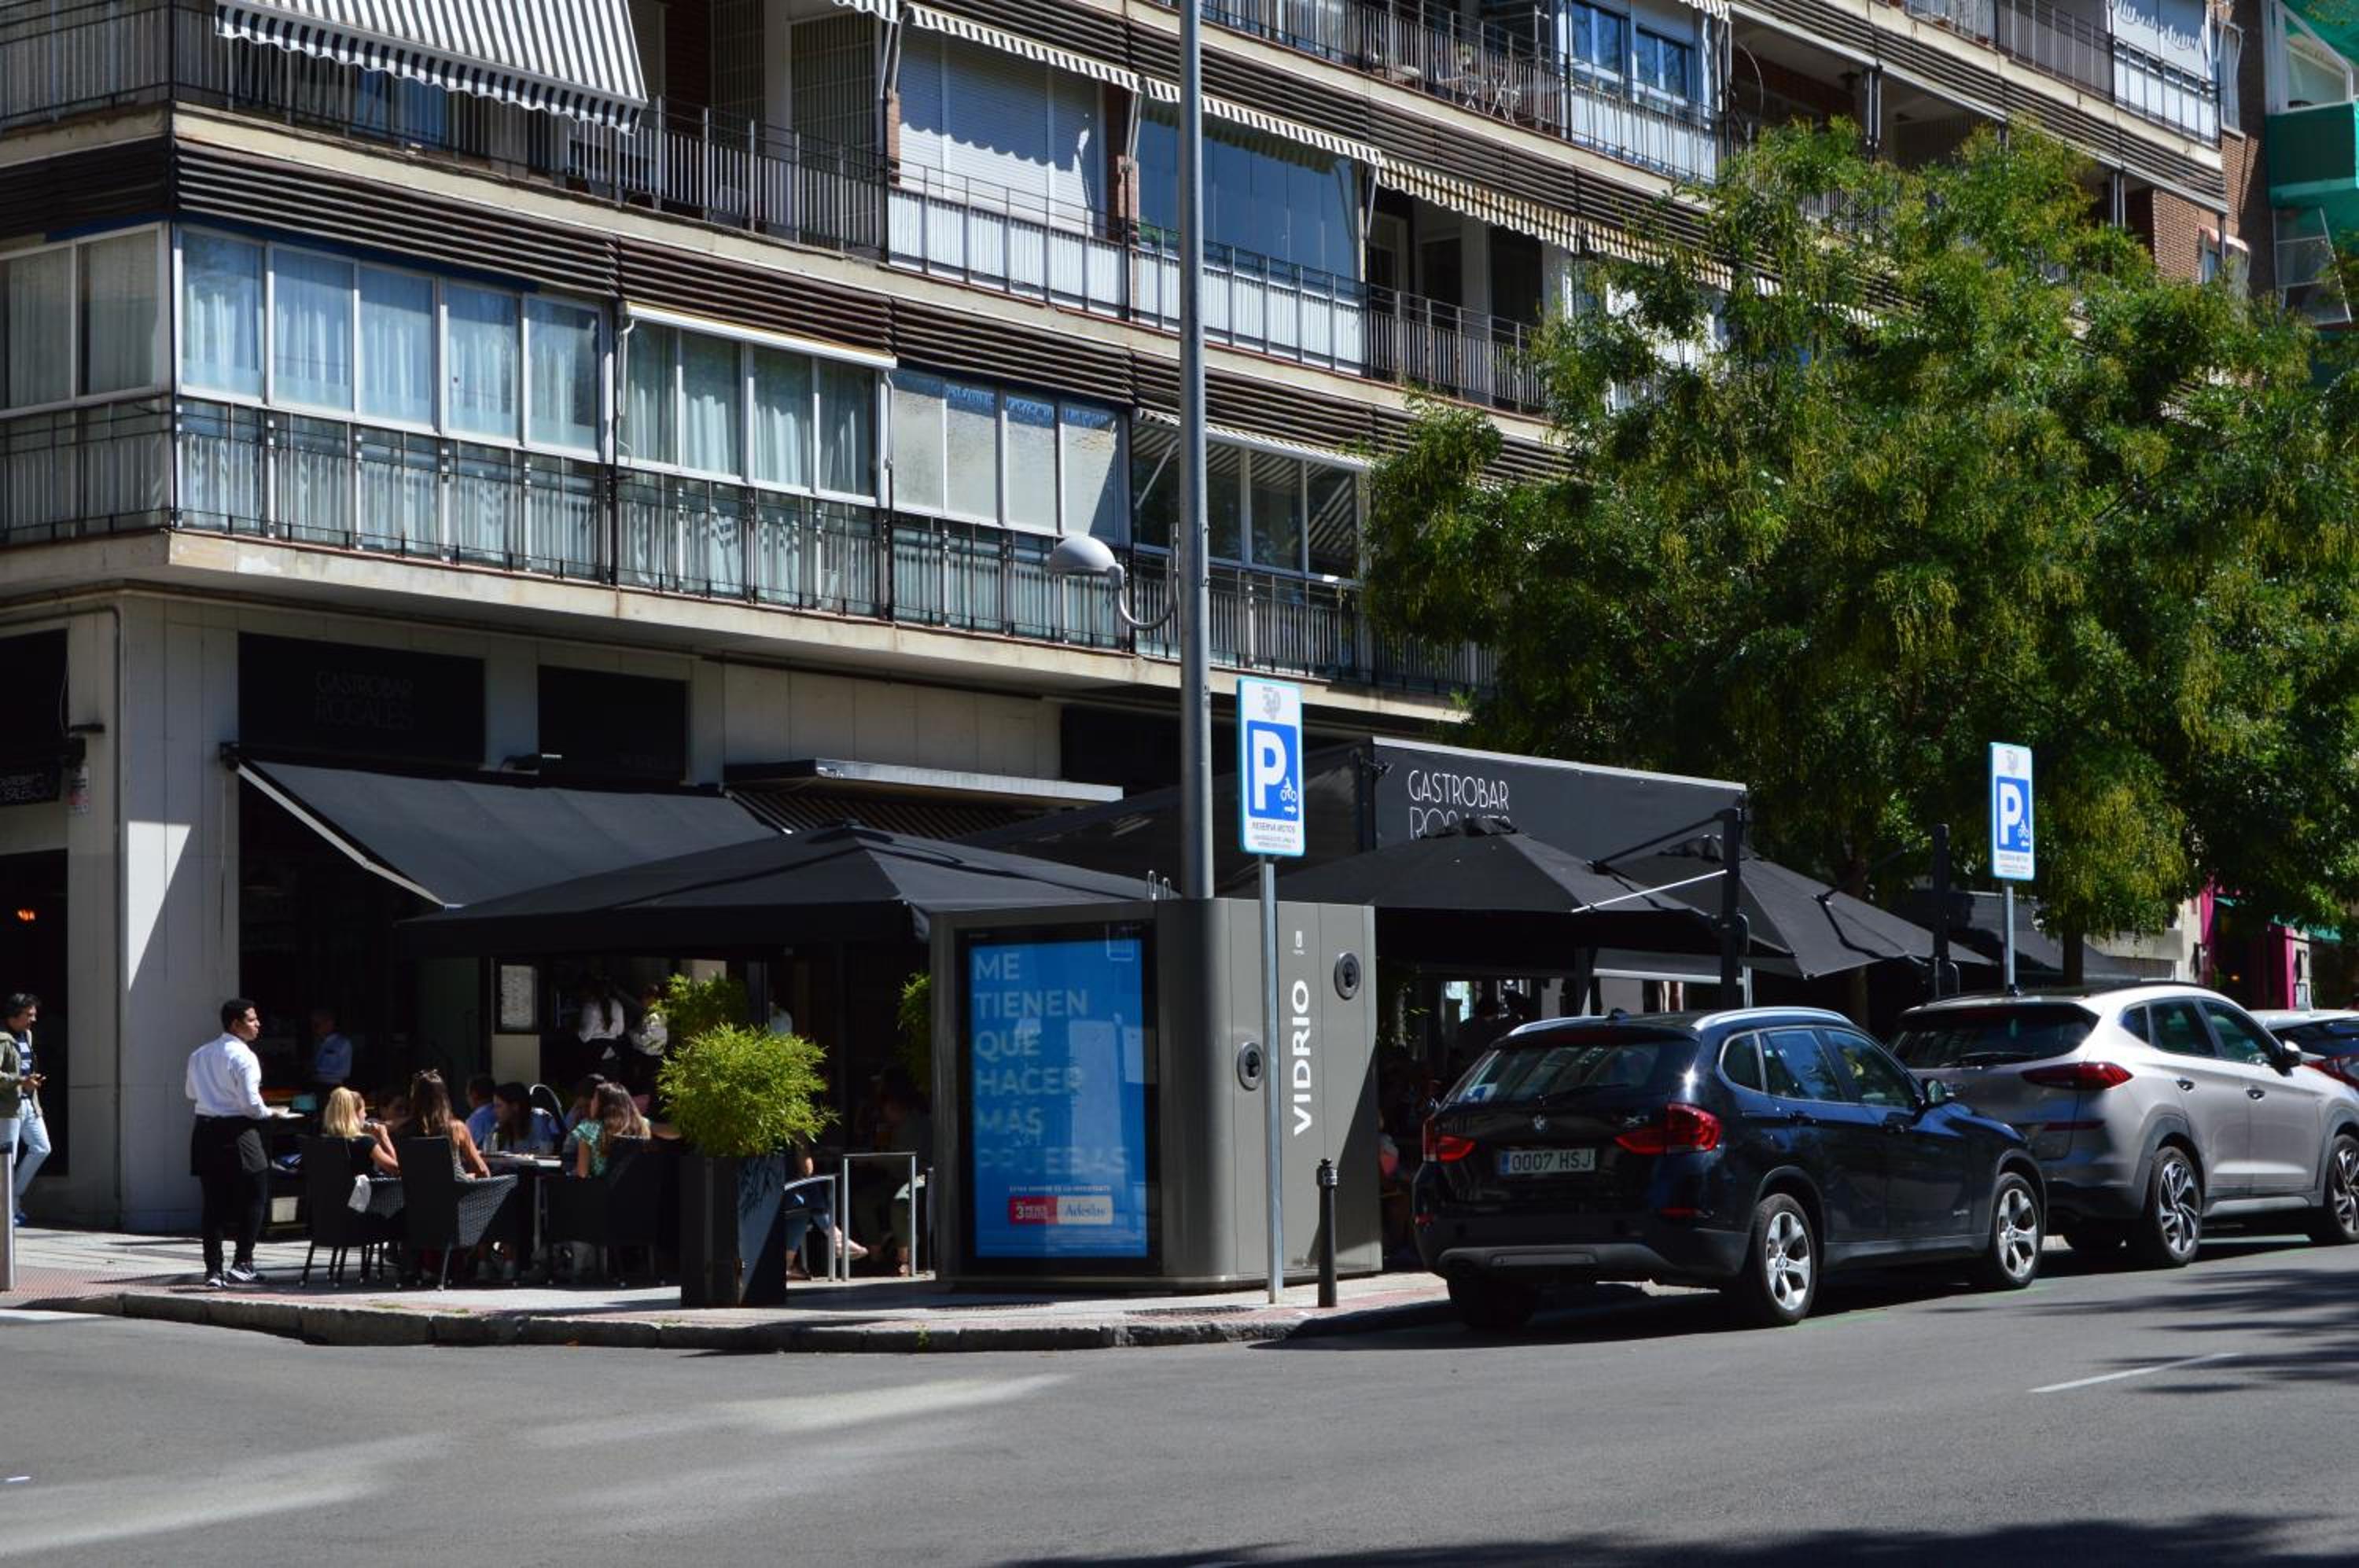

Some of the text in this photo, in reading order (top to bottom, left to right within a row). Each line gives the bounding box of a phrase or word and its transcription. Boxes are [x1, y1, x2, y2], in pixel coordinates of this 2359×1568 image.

[1253, 729, 1286, 810] P
[1408, 769, 1509, 811] GASTROBAR
[2000, 782, 2023, 845] P
[974, 952, 1020, 981] ME
[974, 989, 1088, 1019] TIENEN
[975, 1029, 1042, 1062] QUE
[1292, 980, 1312, 1137] VIDRIO
[975, 1066, 1084, 1097] HACER
[1512, 1150, 1591, 1171] 0007 HSJ
